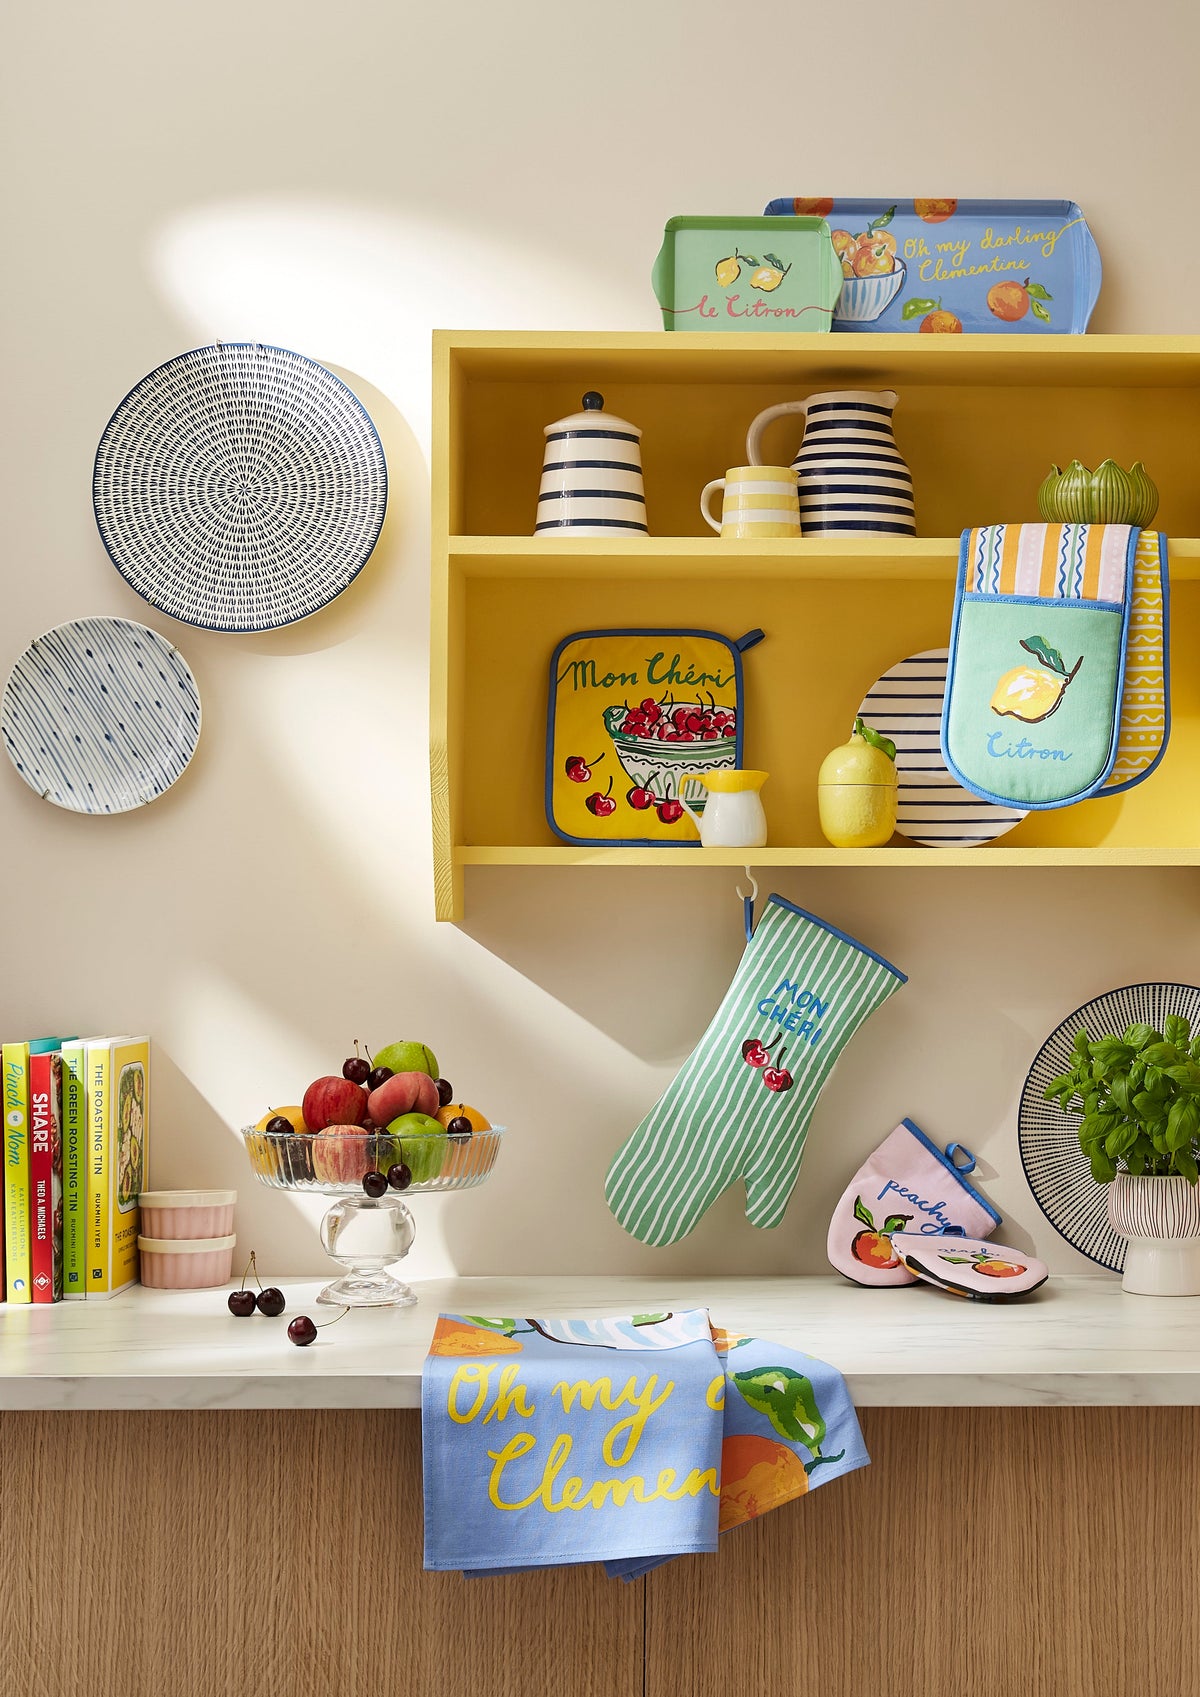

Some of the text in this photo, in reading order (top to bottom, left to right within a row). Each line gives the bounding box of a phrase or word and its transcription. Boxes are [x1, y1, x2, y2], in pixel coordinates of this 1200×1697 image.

[904, 226, 1064, 267] Oh my darling
[918, 255, 1032, 282] Clementine
[697, 294, 801, 318] le Citron
[565, 652, 732, 691] Mon Chéri
[986, 730, 1073, 762] Citron
[757, 998, 822, 1045] CHÉRI
[774, 978, 829, 1019] MON
[7, 1062, 25, 1167] Pinch Nom
[33, 1093, 49, 1153] SHARE
[68, 1058, 78, 1212] THE GREEN ROASTING TIN
[94, 1064, 103, 1175] THE ROASTING TIN
[36, 1180, 46, 1240] THEO A. MICHAELS
[877, 1179, 951, 1234] peachy
[447, 1362, 535, 1426] Oh
[551, 1372, 675, 1468] my
[487, 1432, 721, 1514] Clemen
